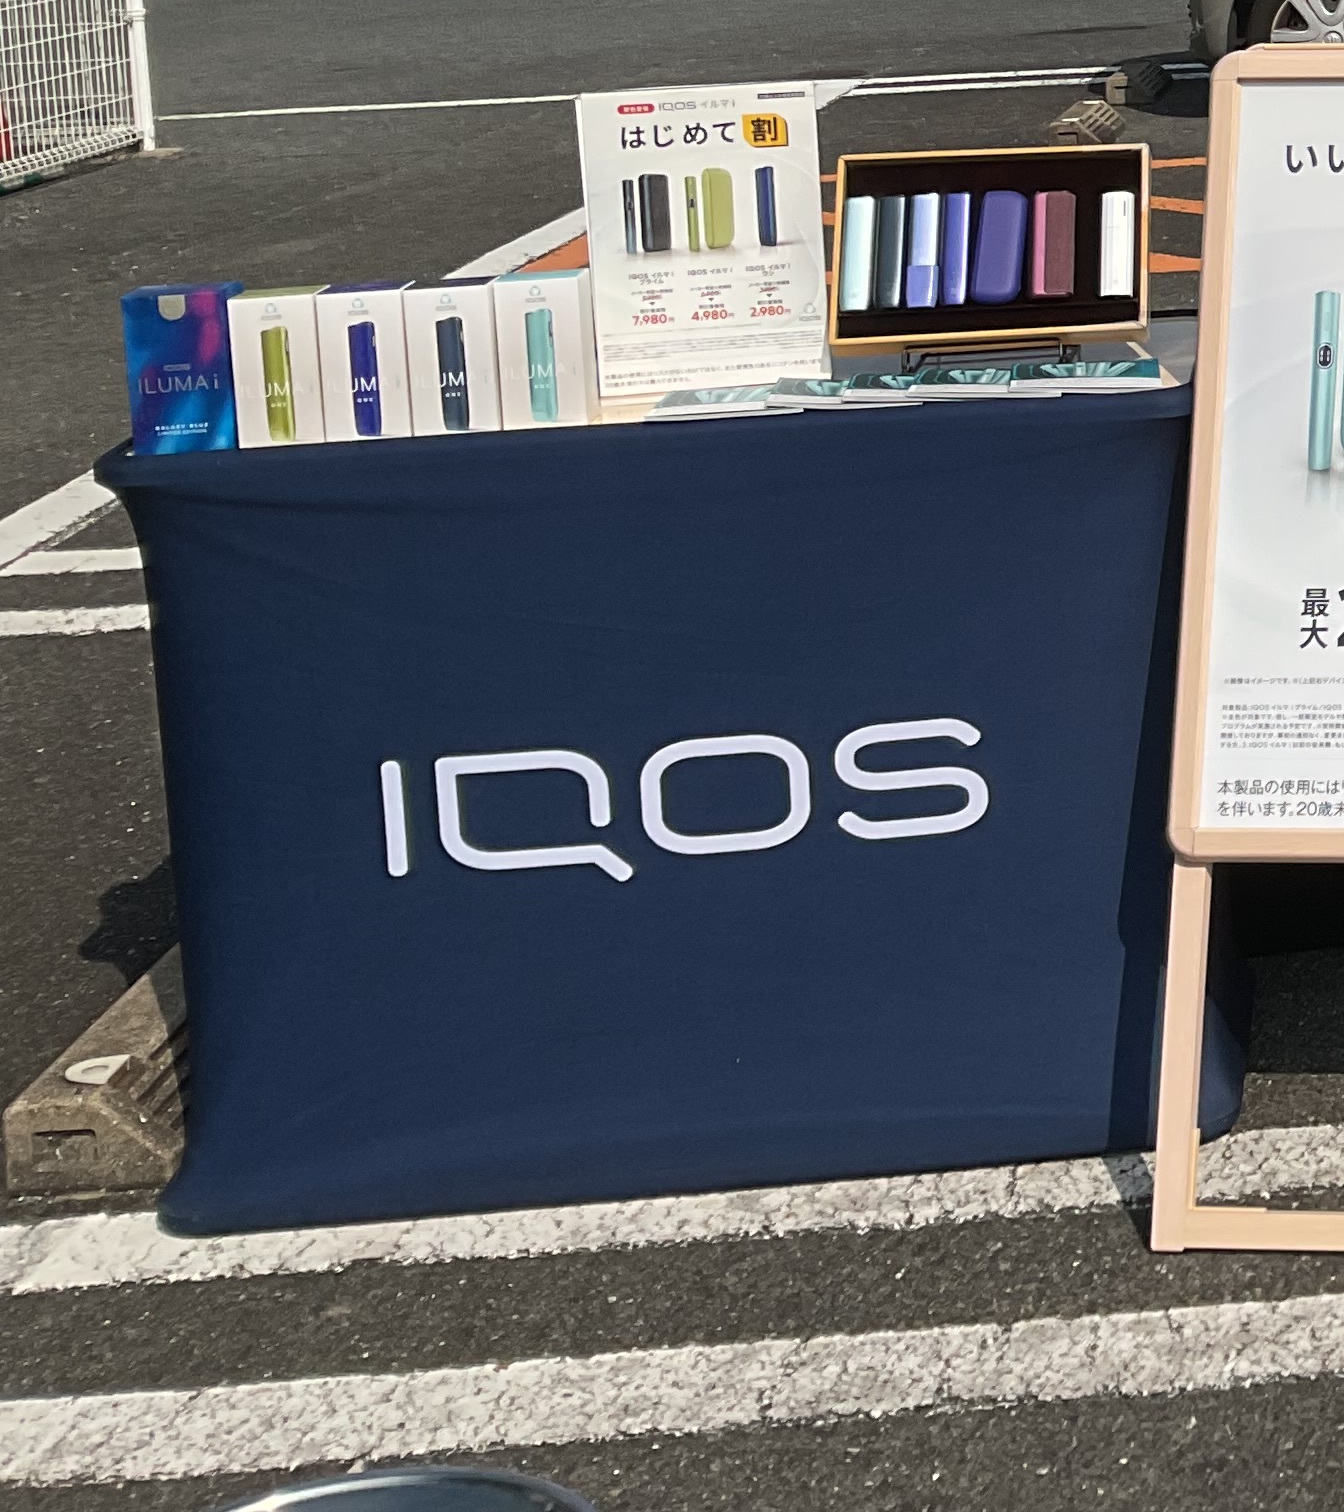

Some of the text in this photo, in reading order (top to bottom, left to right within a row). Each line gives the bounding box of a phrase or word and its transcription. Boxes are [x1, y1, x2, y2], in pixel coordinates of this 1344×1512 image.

[658, 101, 696, 111] IQOS
[138, 374, 209, 395] ILUMA
[380, 718, 989, 881] IQOS
